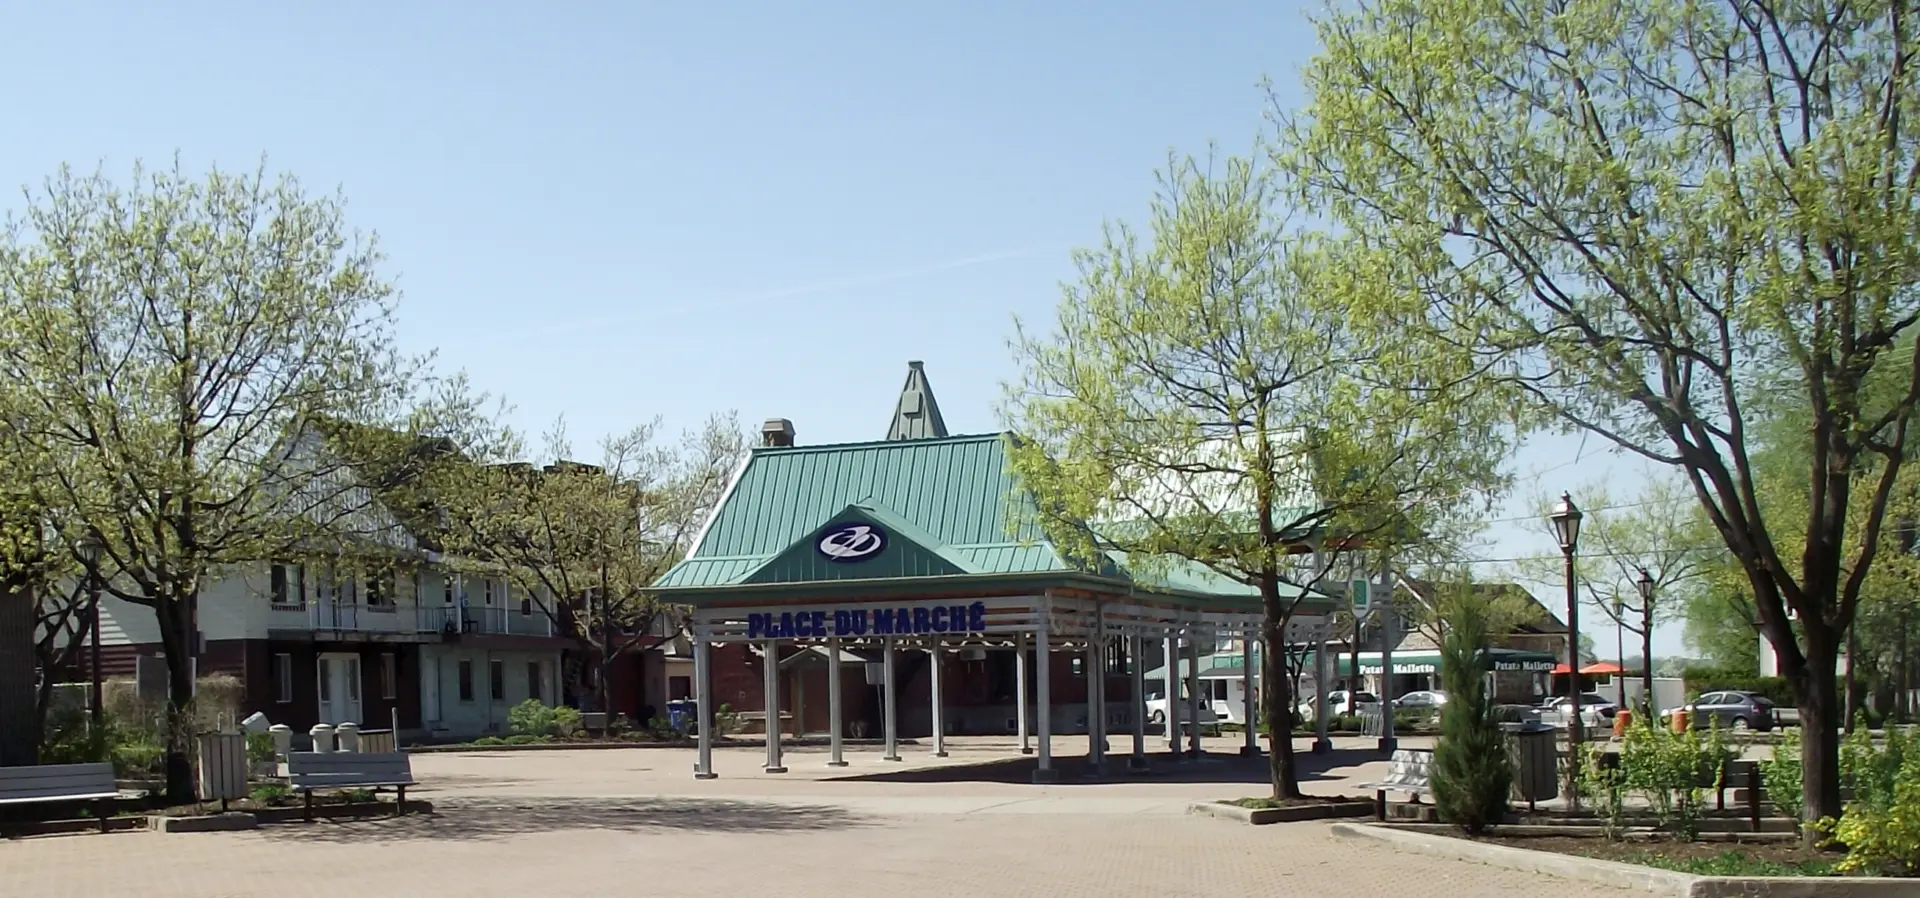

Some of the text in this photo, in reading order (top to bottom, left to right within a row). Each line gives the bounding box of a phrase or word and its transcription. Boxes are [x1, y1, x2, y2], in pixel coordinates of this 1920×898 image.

[748, 600, 986, 639] PLACE DU MARCHÉ
